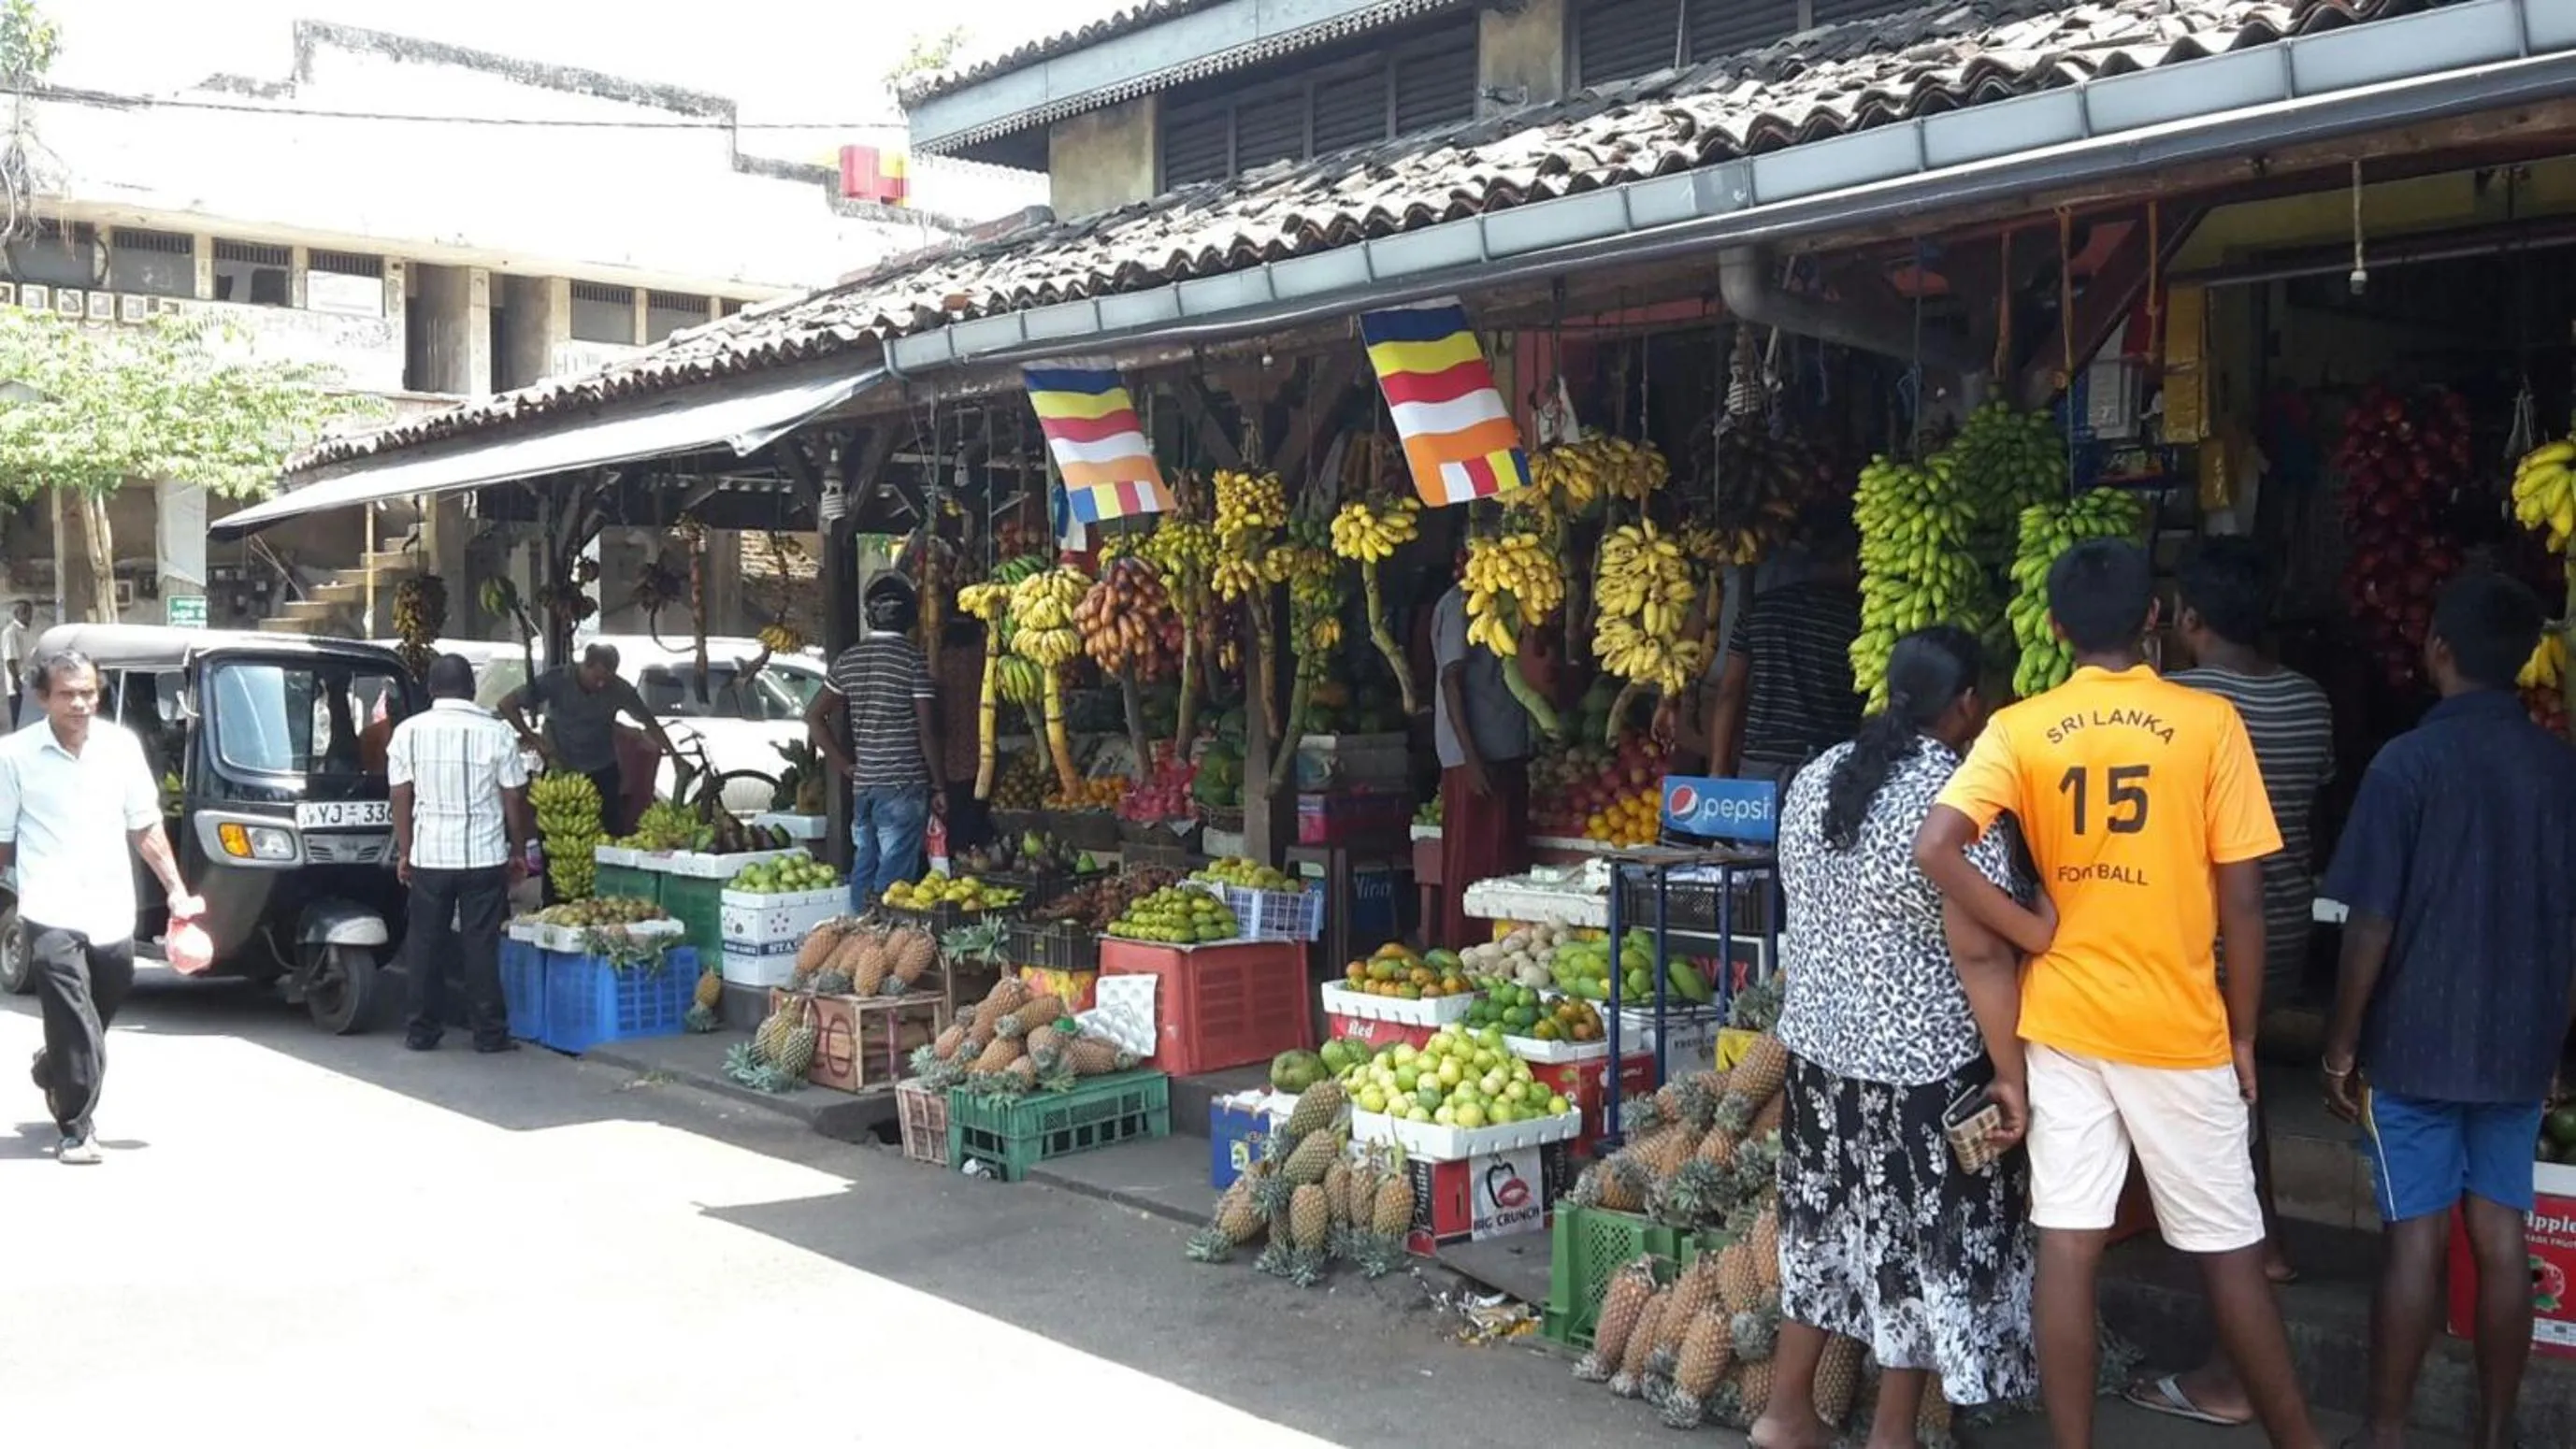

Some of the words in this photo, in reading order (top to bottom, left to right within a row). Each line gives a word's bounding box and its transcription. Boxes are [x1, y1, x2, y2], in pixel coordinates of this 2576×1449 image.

[2047, 713, 2084, 744] SRI
[2093, 708, 2175, 745] LANKA
[1703, 796, 1772, 824] pepsi
[2059, 765, 2150, 835] 15
[1348, 1019, 1375, 1039] Red
[1496, 1204, 1540, 1227] CRUNCH
